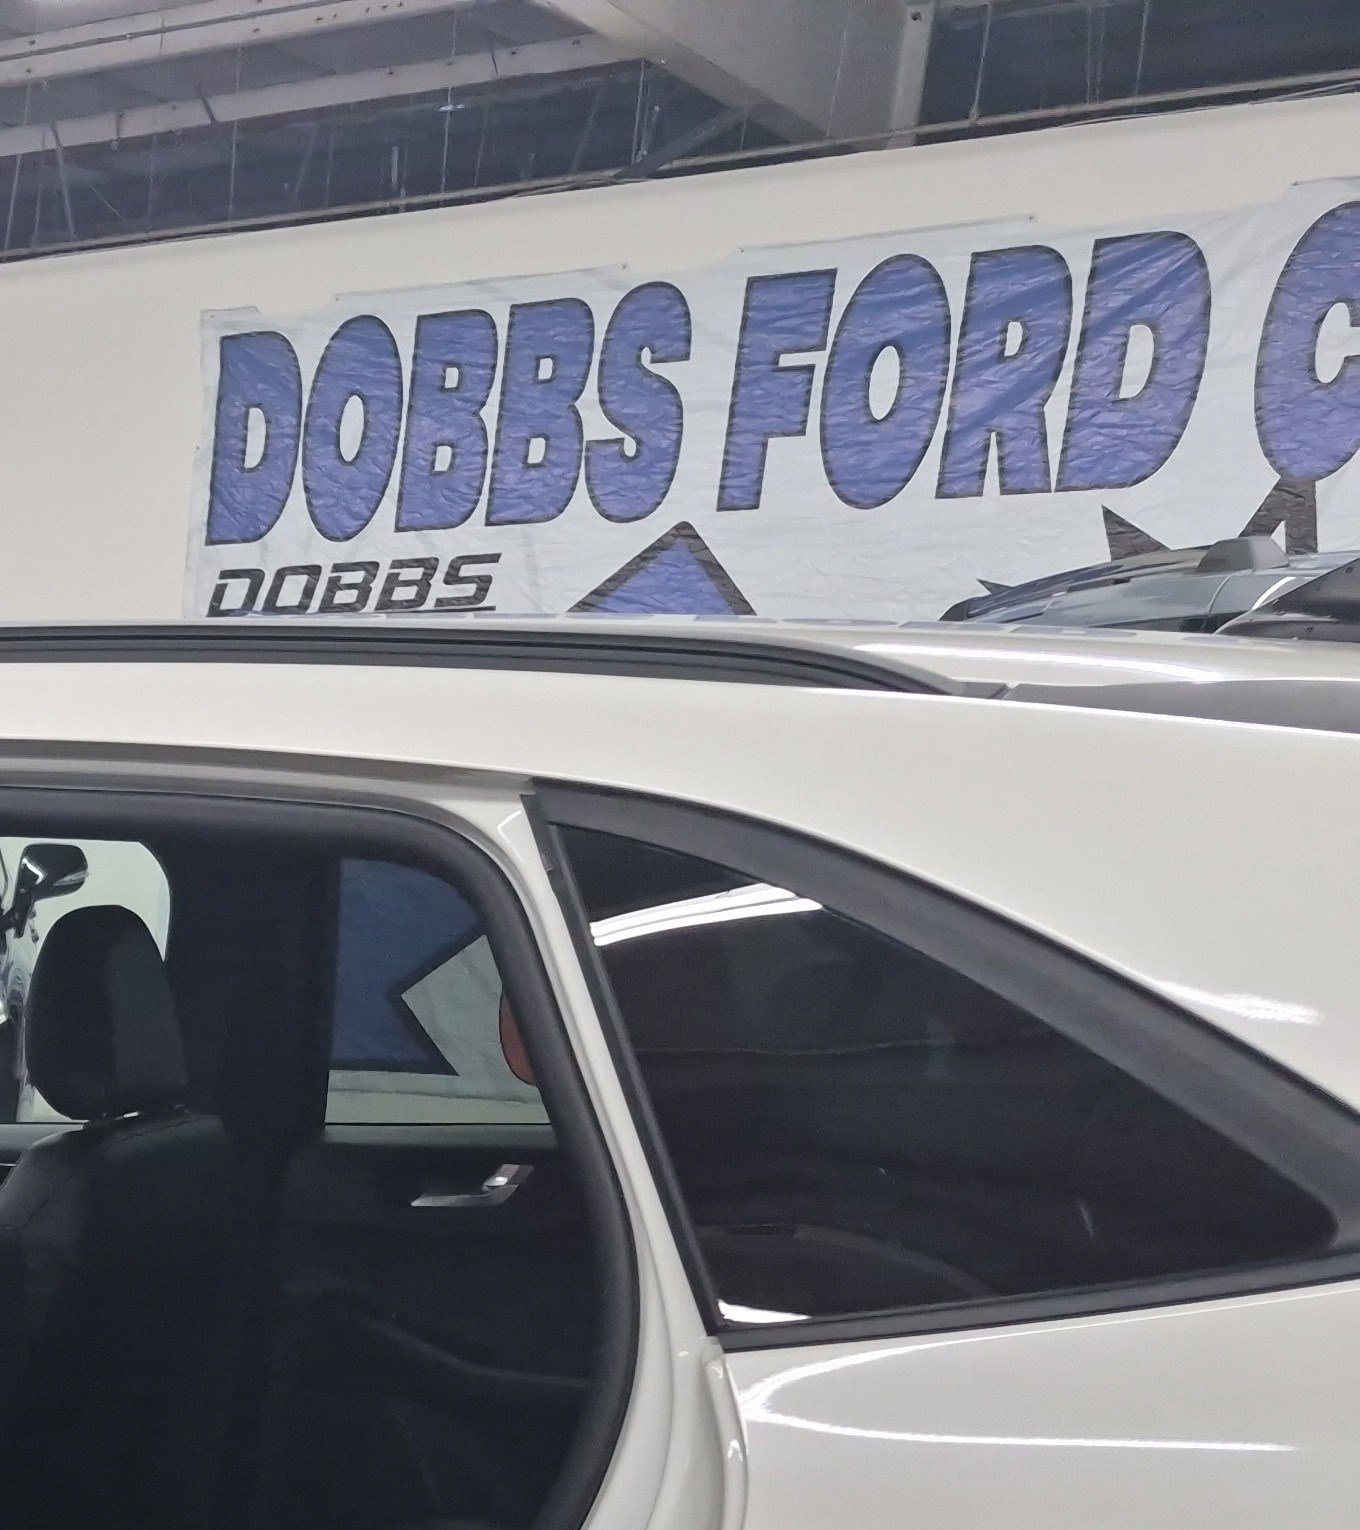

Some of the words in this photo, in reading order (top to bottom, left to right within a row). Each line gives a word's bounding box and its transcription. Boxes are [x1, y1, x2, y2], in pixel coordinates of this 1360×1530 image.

[204, 281, 692, 545] DOBBS
[716, 230, 1213, 512] FORD
[205, 552, 502, 617] DOBBS
